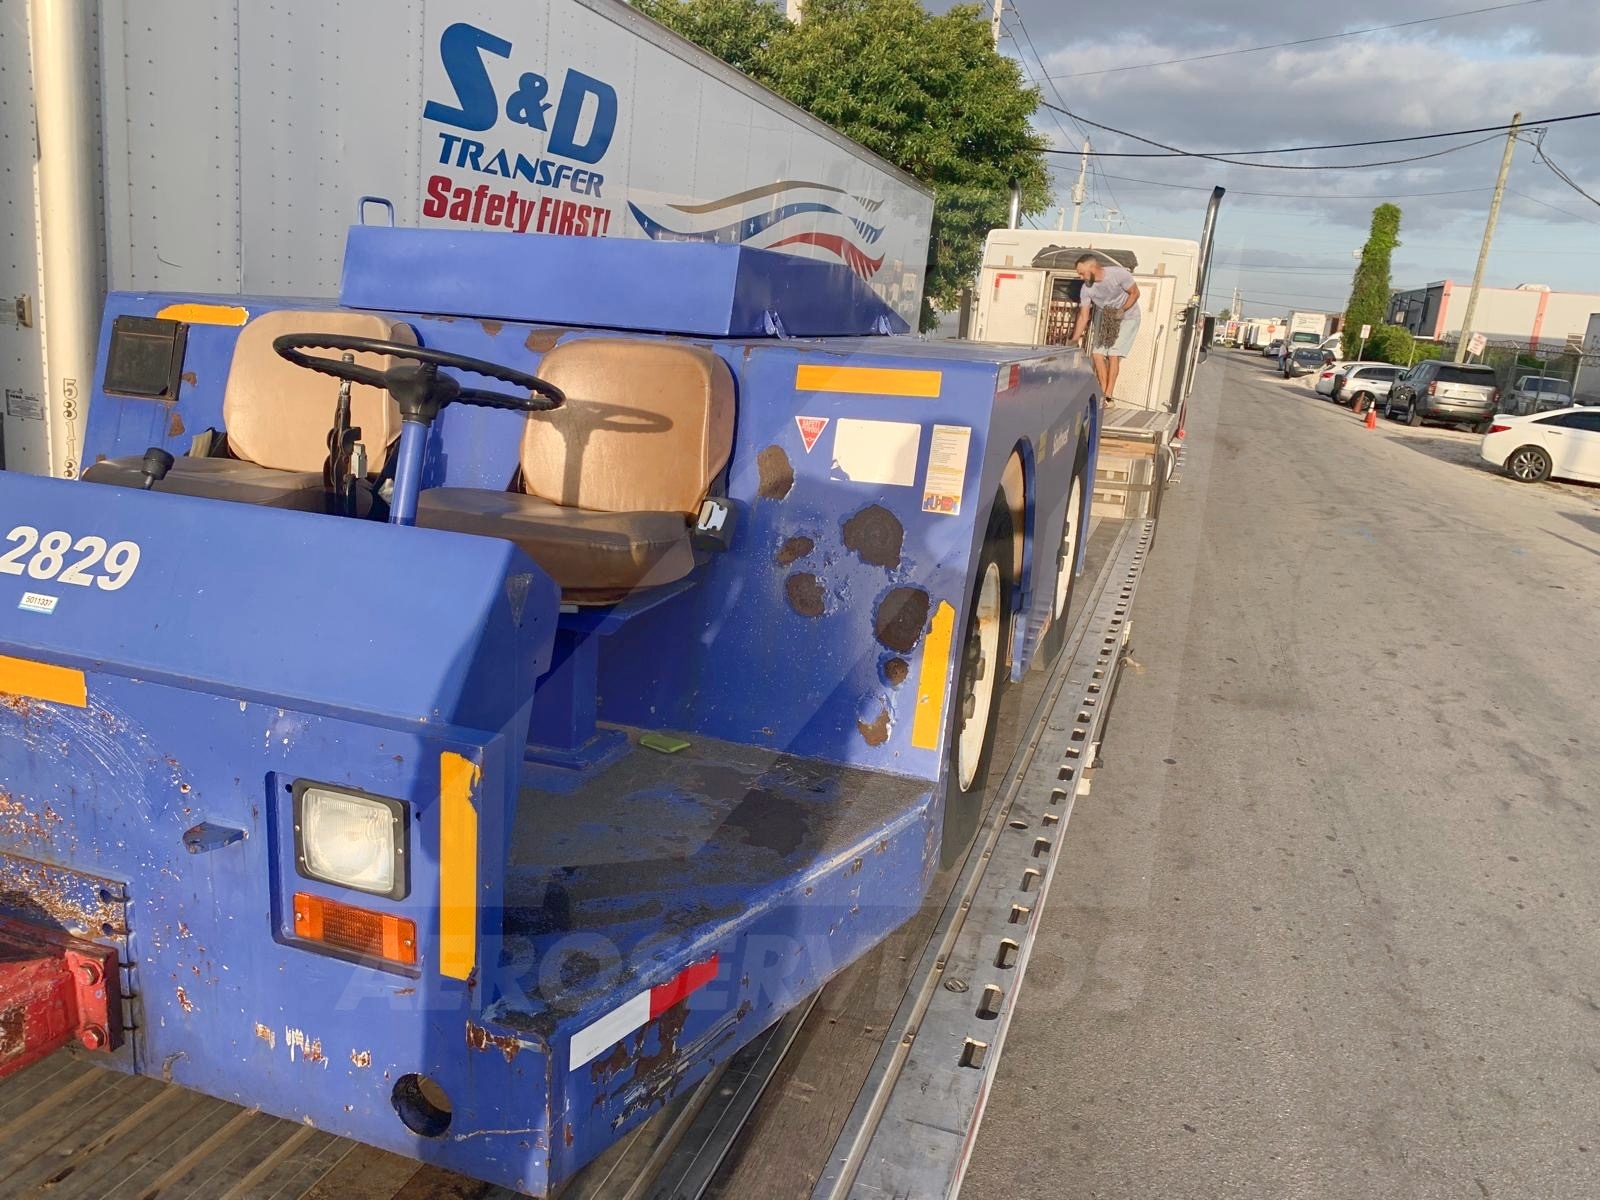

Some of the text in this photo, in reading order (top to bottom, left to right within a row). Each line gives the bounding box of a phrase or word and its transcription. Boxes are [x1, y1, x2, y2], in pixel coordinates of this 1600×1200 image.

[423, 22, 618, 165] S&D
[438, 132, 604, 198] TRANSFER
[423, 175, 611, 237] Safety FIRST!
[0, 525, 141, 591] 2829
